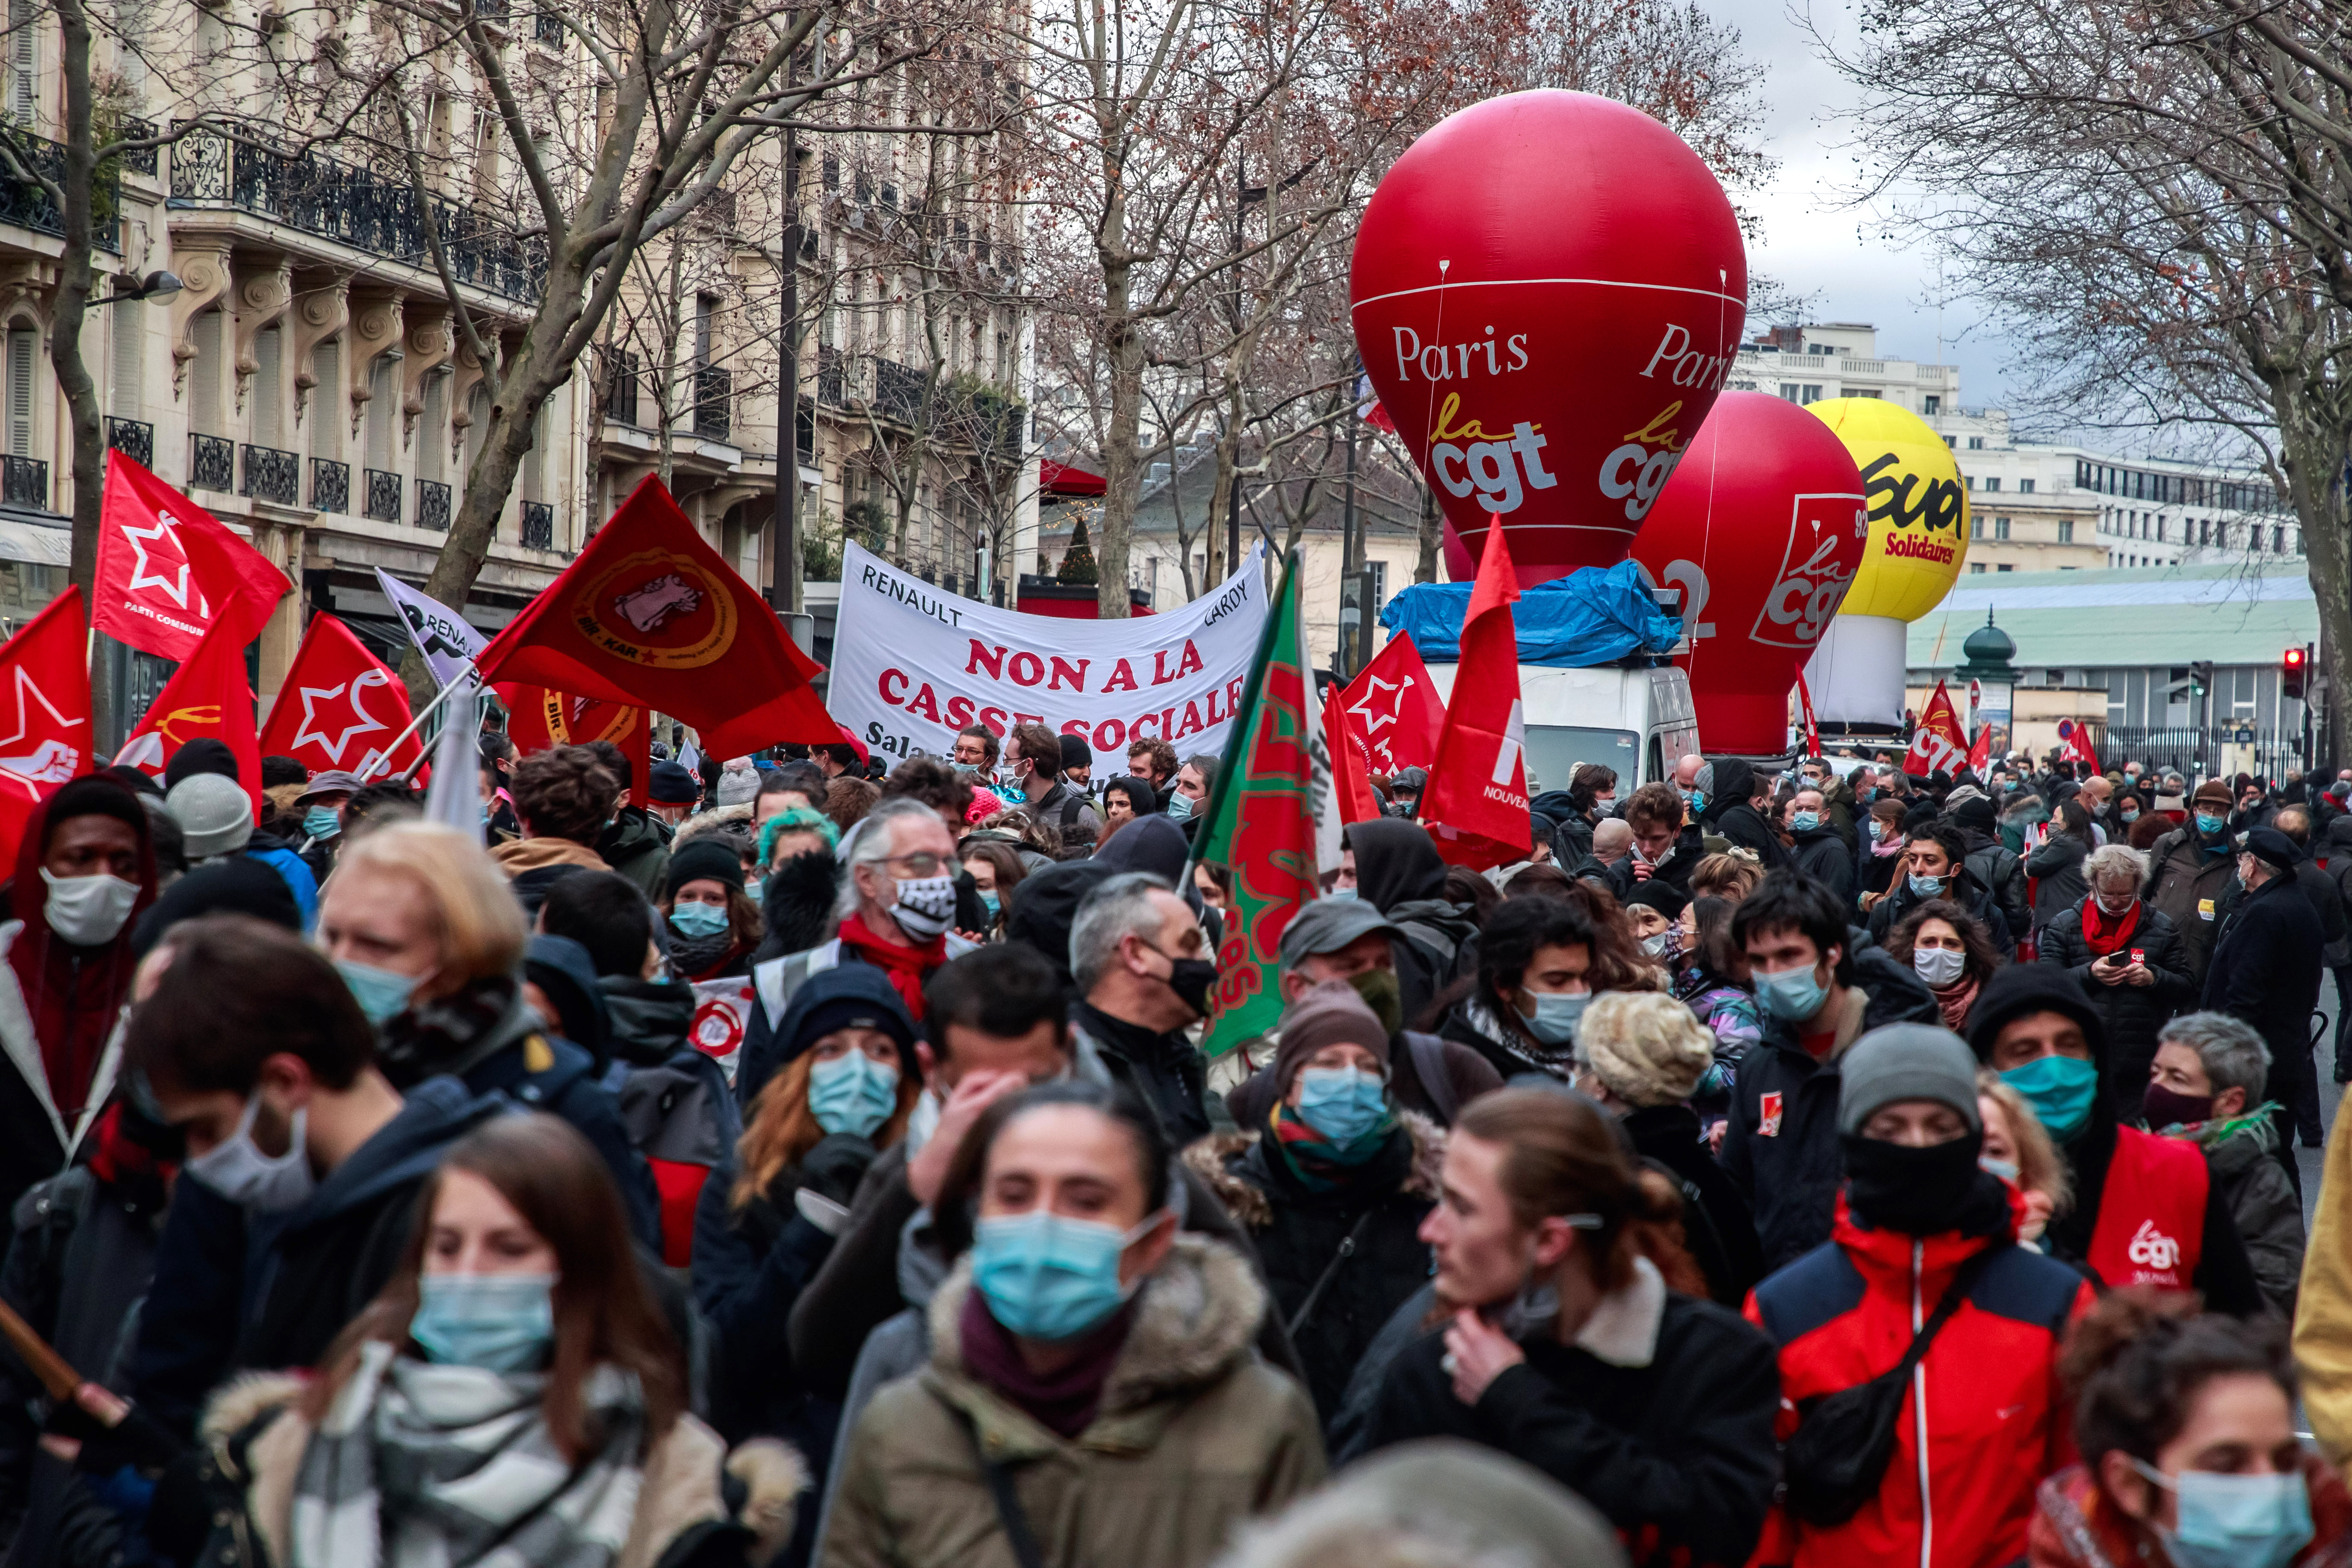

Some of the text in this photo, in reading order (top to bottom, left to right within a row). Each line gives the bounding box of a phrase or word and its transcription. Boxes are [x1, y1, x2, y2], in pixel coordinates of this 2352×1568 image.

[1393, 325, 1528, 381] Paris
[1639, 323, 1735, 391] Pari
[1429, 392, 1516, 443] la
[1624, 401, 1683, 452] la
[1432, 421, 1558, 514] cgt
[1788, 534, 1848, 580] la
[1885, 532, 1955, 565] Solidaires
[124, 601, 154, 618] PARTI
[862, 564, 963, 627] RENAULT
[1204, 579, 1248, 627] LARDY
[602, 638, 638, 659] KAR
[964, 638, 1204, 693] NON A LA
[1913, 727, 1968, 781] cgt
[2132, 954, 2145, 962] cgt
